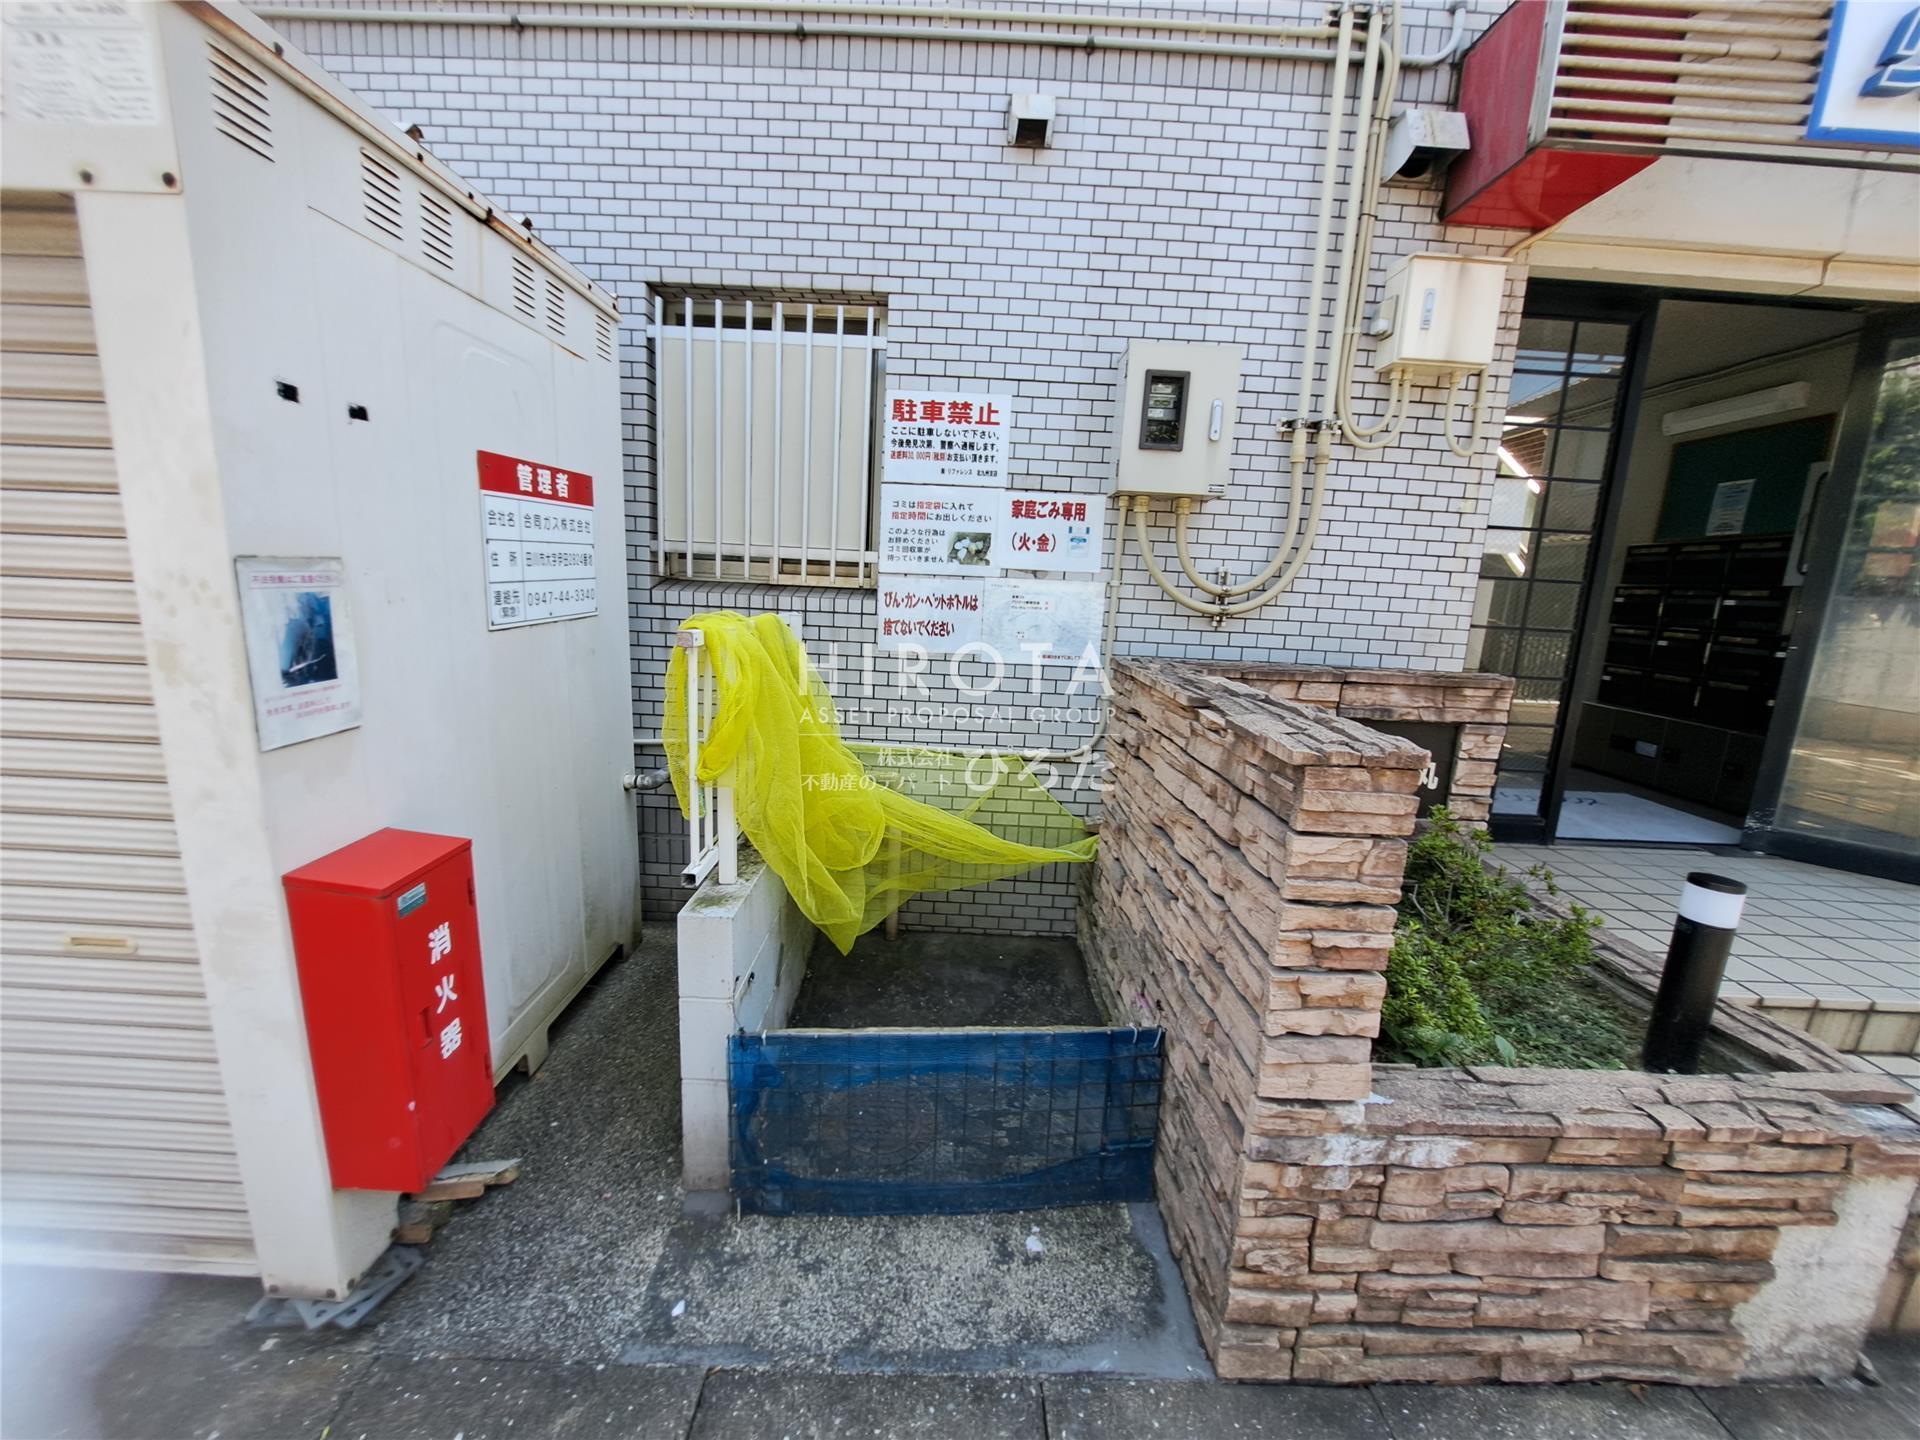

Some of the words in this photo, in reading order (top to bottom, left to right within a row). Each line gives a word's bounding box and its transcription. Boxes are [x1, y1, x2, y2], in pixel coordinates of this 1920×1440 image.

[892, 399, 1000, 426] 駐車禁止
[891, 426, 999, 440] ここに駐車しないで下さい。
[516, 463, 569, 498] 管理者
[892, 500, 974, 511] ゴミは指定袋に入れて
[1011, 499, 1087, 522] 家庭ごみ専用
[488, 510, 515, 527] 会社名
[891, 511, 992, 522] 指定時間にお出しください
[888, 528, 946, 536] このような行為は
[887, 554, 944, 563] 持っていきません
[527, 588, 595, 606] 0947-44-3340
[884, 591, 979, 611] びん・カン・ペットボトルは
[883, 617, 955, 637] 捨てないでください
[428, 921, 462, 1060] 消火器
